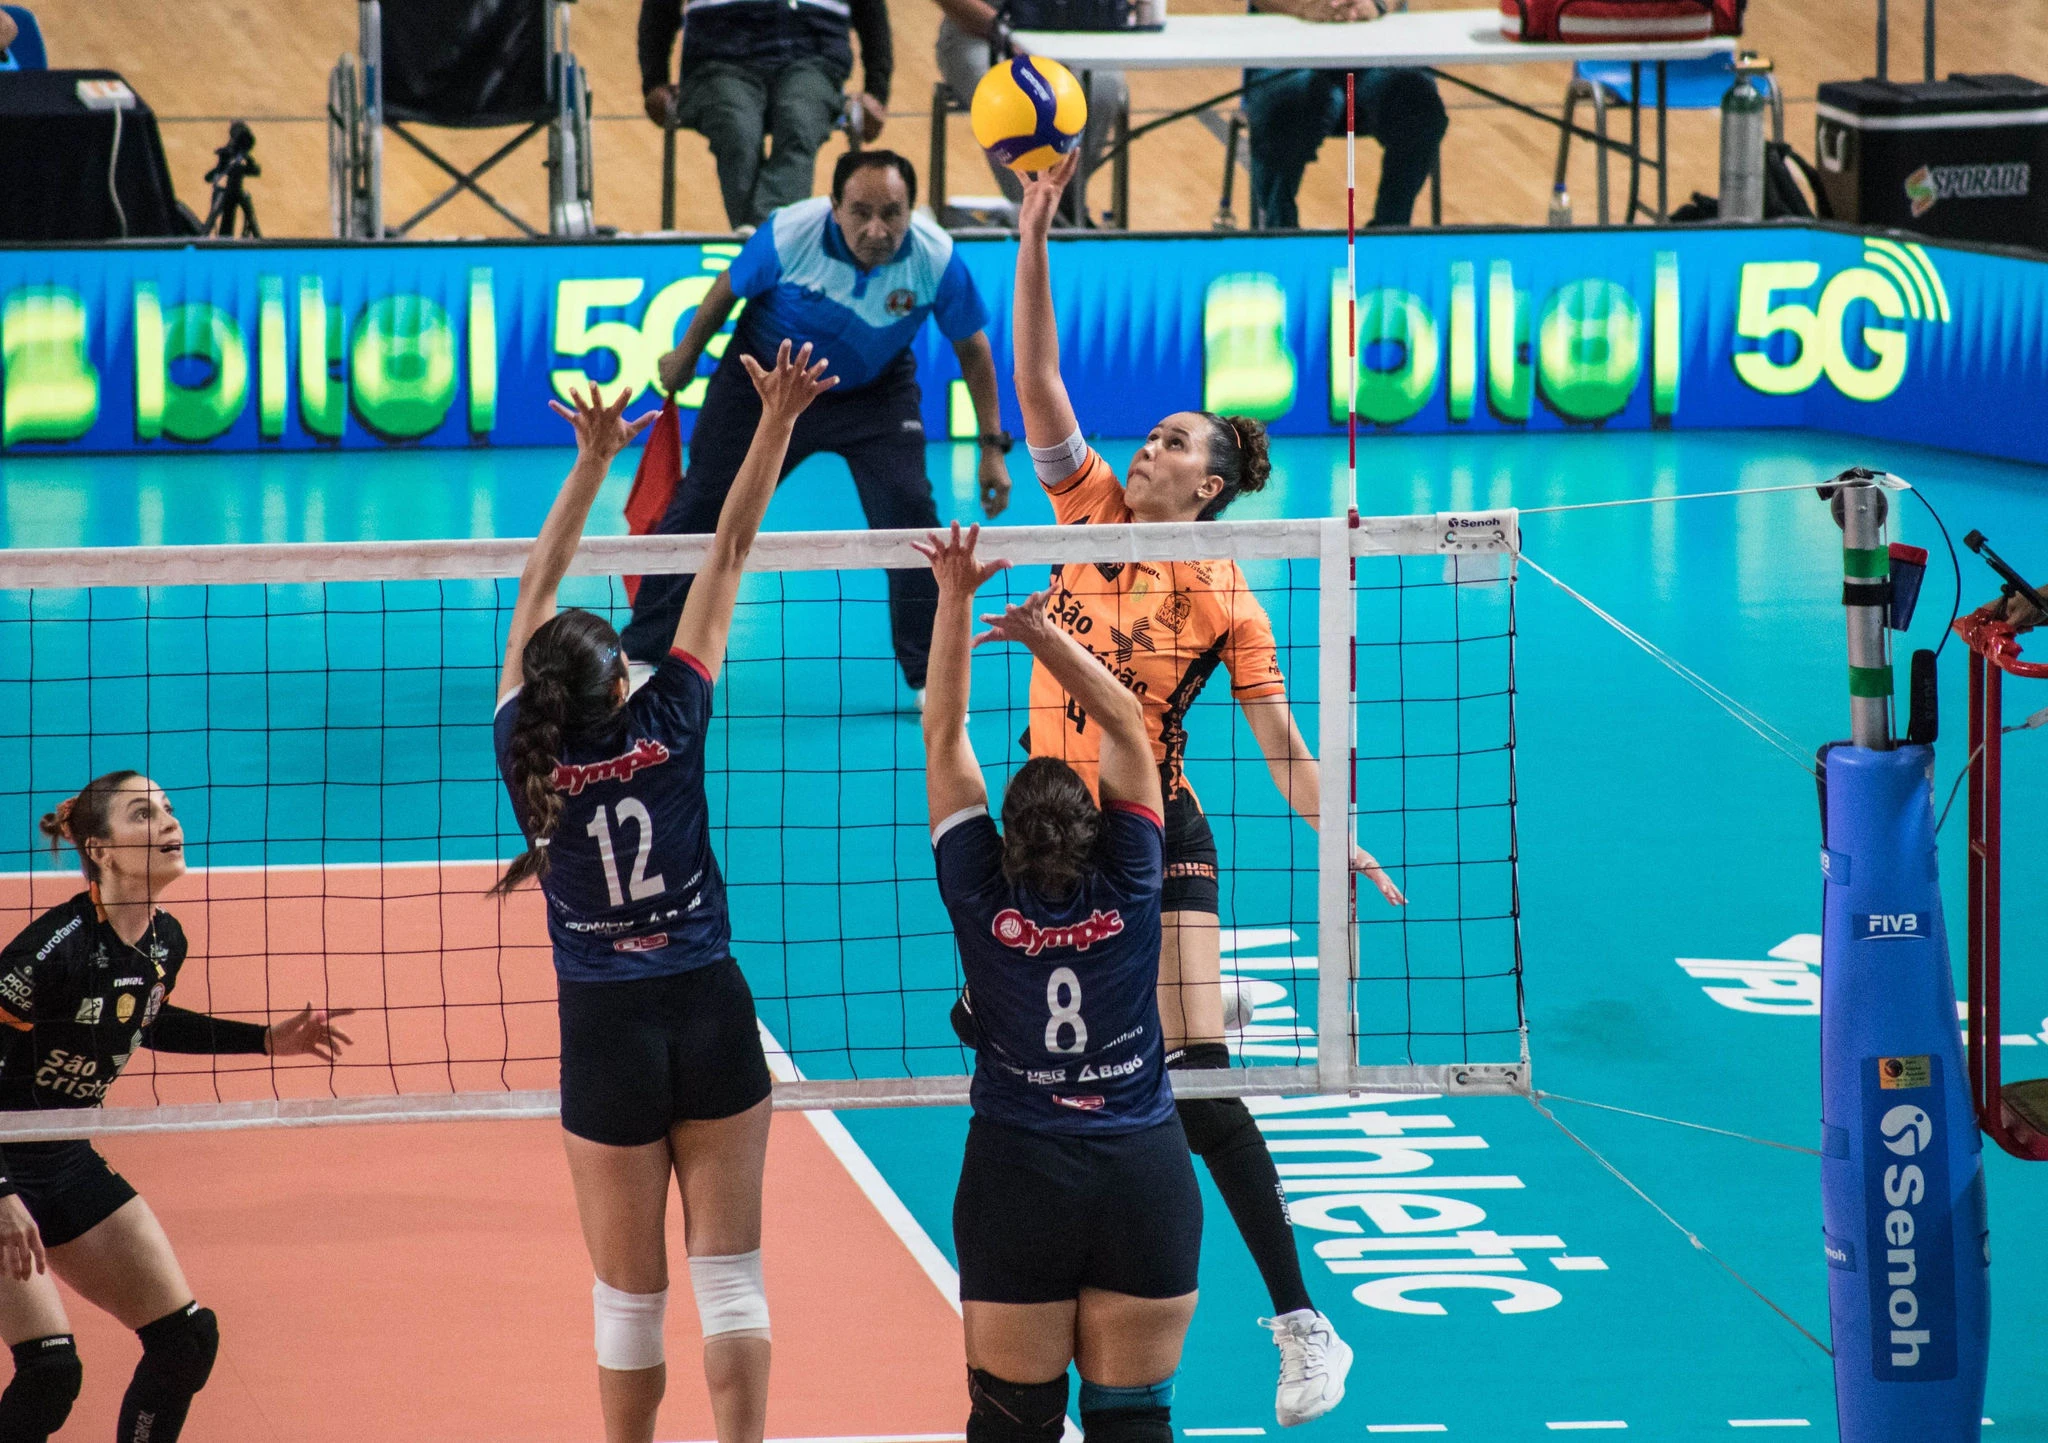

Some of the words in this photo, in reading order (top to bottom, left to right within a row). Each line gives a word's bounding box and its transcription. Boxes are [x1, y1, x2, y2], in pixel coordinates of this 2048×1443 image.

[1733, 261, 1908, 403] 5G
[1460, 518, 1501, 528] Senoh
[1053, 589, 1093, 635] São
[586, 797, 666, 908] 12
[992, 909, 1124, 956] Olympic
[0, 981, 34, 1013] ORCE
[3, 973, 33, 998] PRO
[1045, 967, 1088, 1053] 8
[44, 1048, 98, 1077] São
[1099, 1054, 1144, 1079] Bagó
[1883, 1164, 1931, 1367] Senoh
